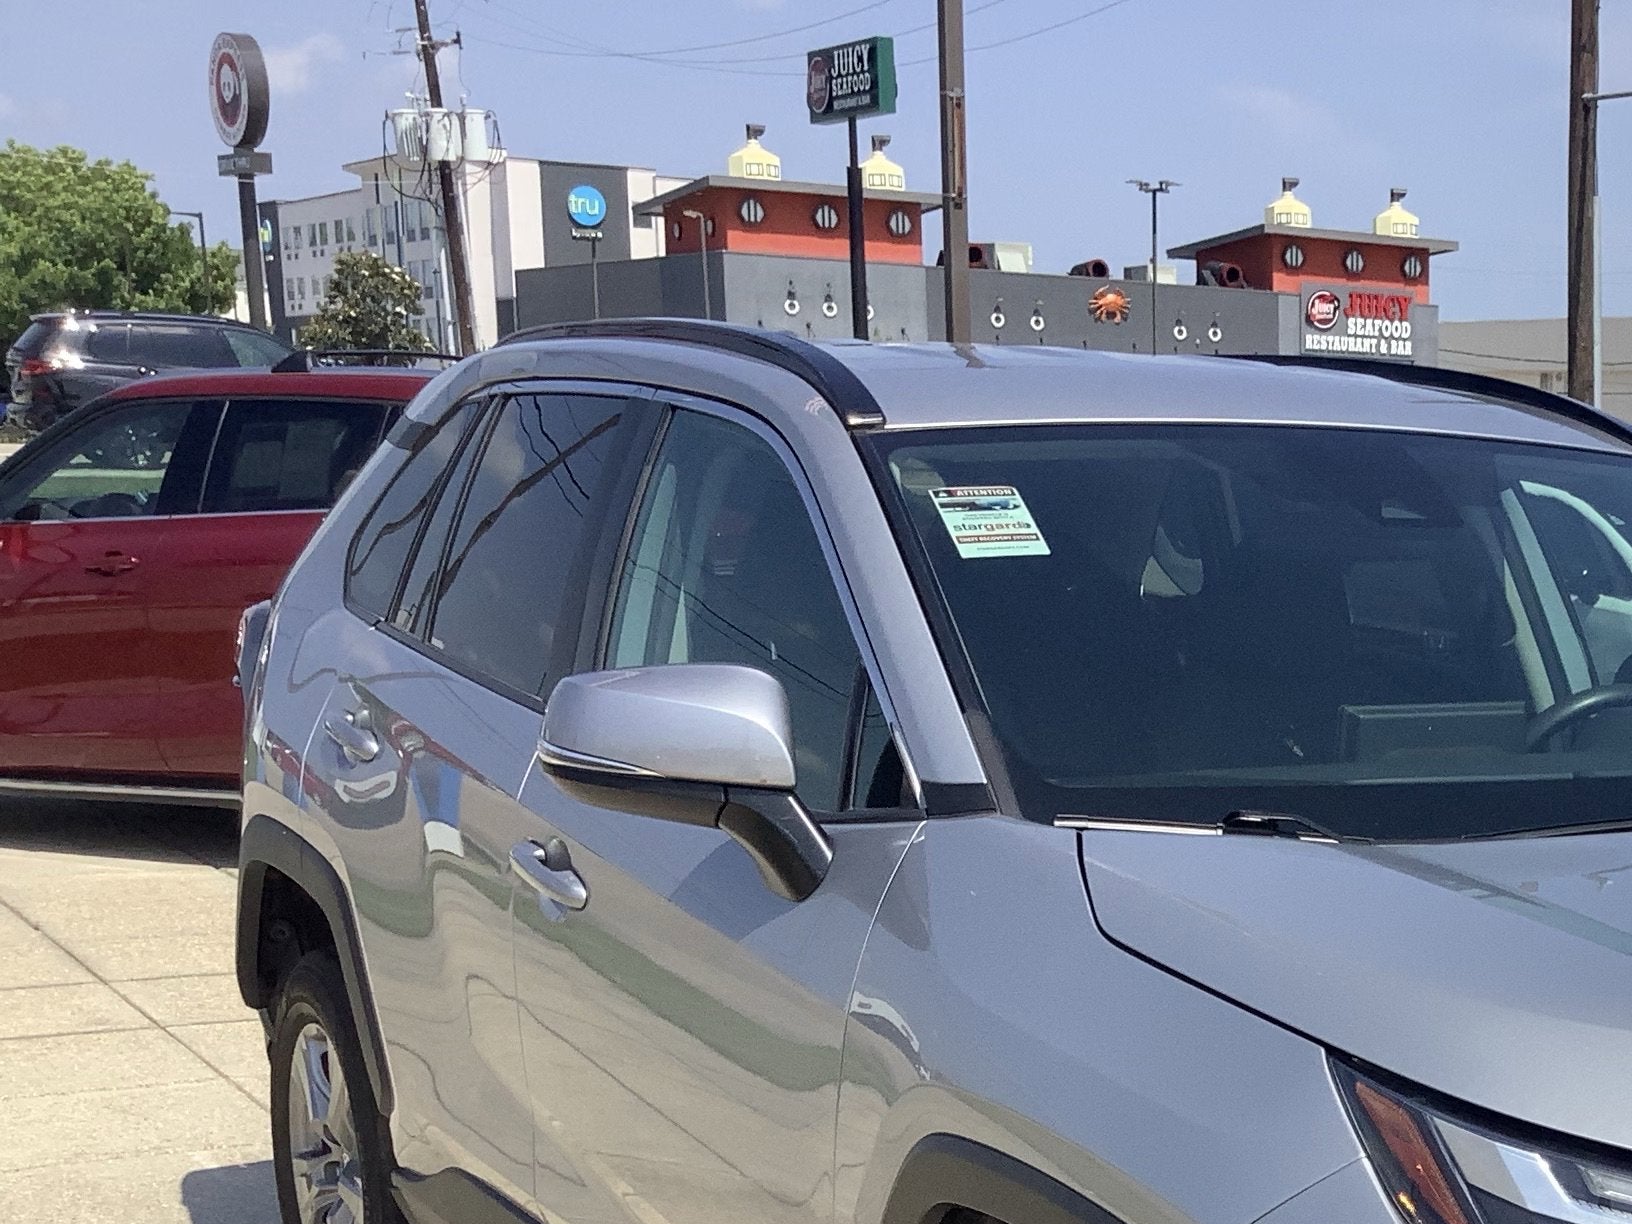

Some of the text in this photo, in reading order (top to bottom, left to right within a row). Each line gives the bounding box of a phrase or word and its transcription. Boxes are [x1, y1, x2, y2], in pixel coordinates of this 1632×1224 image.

[831, 44, 870, 77] JUICY
[832, 72, 871, 97] SEAFOOD
[568, 194, 599, 215] tru
[1344, 291, 1411, 320] JUICY
[1347, 317, 1411, 339] SEAFOOD
[1305, 334, 1412, 355] RESTAURANT & BAR
[956, 488, 1012, 497] ATTENTION
